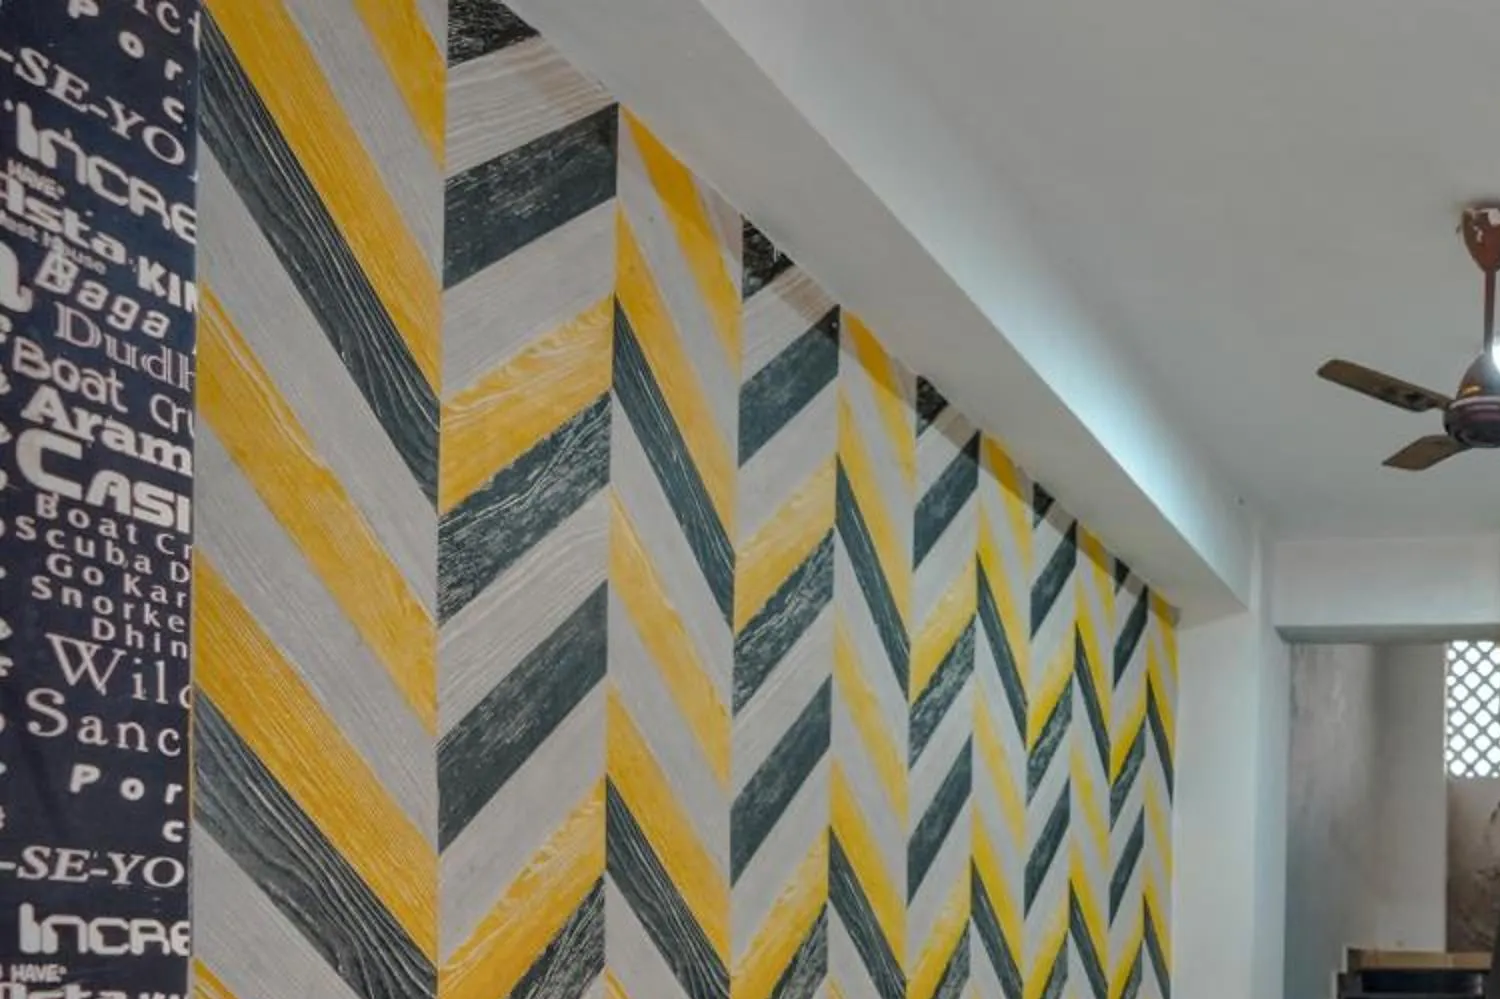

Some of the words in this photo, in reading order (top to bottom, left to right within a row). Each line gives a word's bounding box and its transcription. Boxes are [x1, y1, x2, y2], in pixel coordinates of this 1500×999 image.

[13, 336, 128, 413] Boat
[16, 515, 152, 574] Scuba
[36, 494, 139, 545] Boat
[46, 552, 104, 587] Go
[26, 687, 182, 758] Sanc
